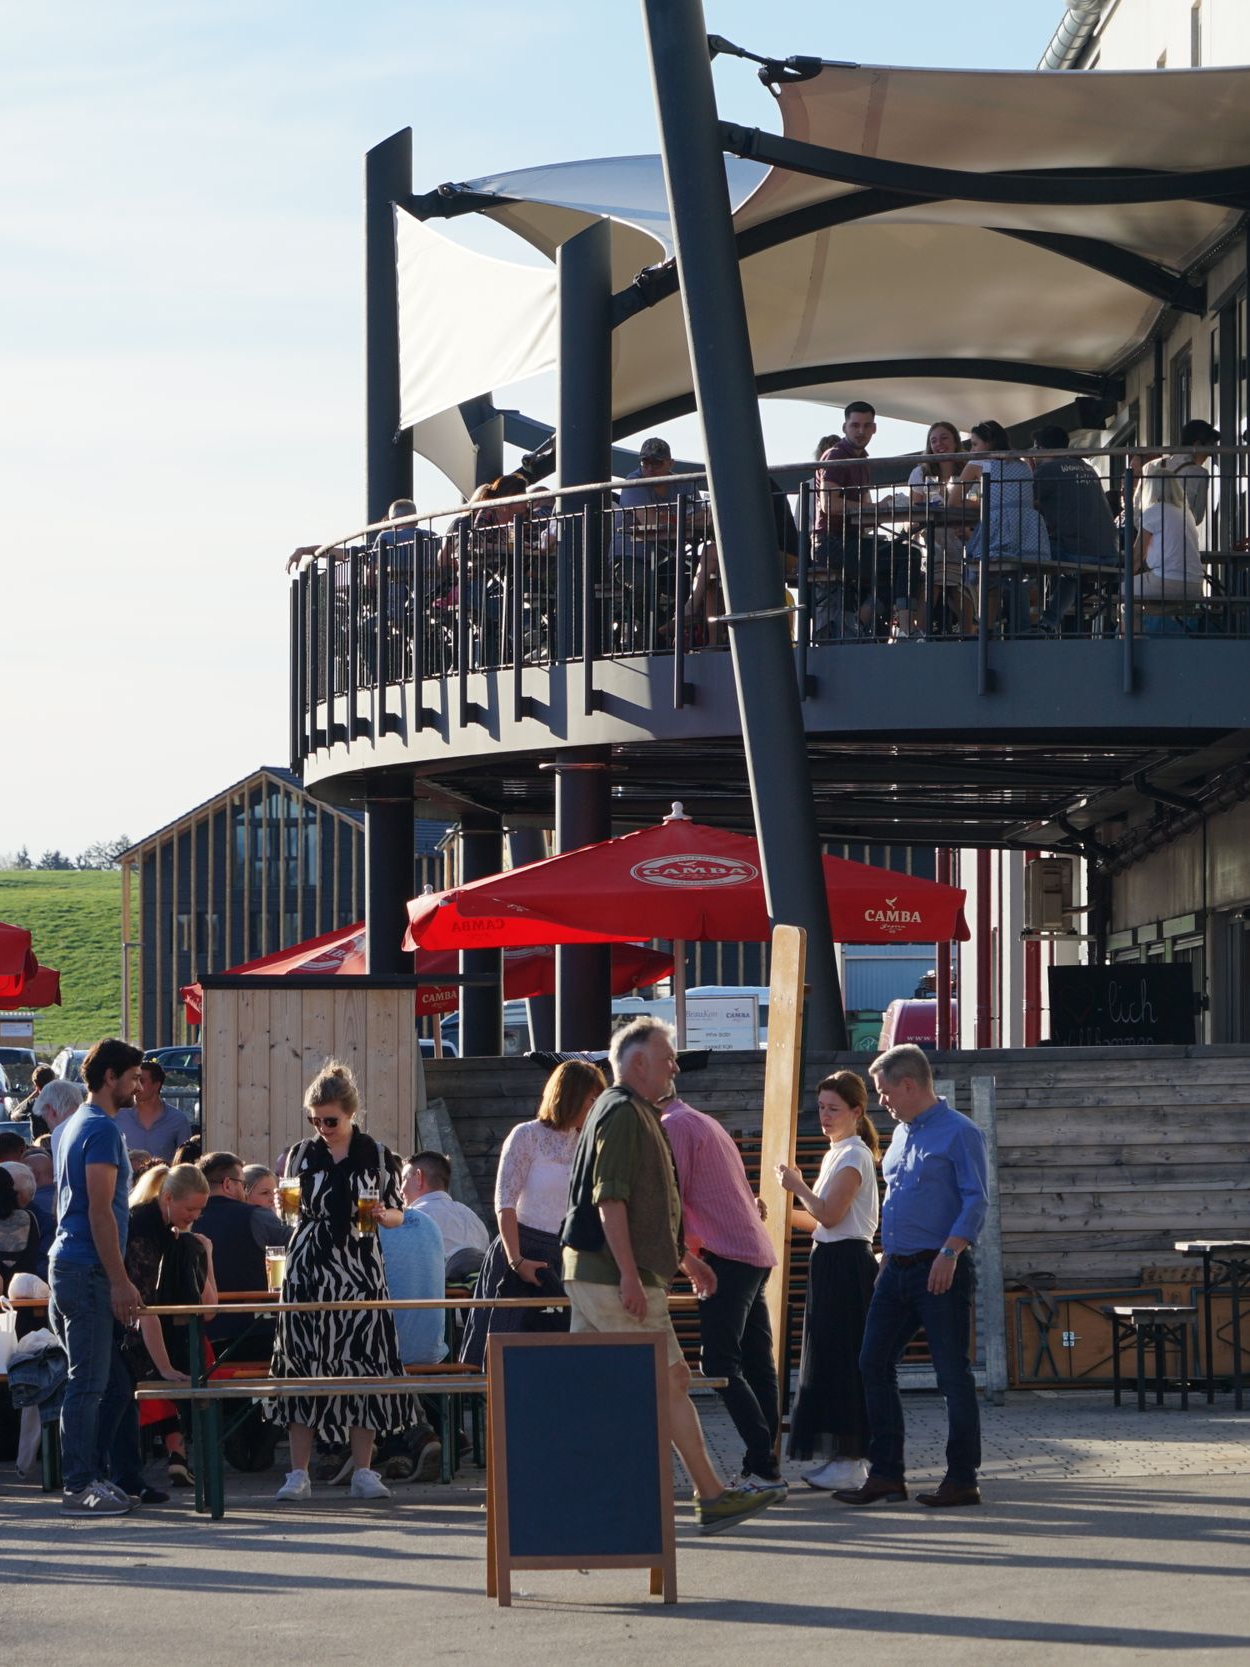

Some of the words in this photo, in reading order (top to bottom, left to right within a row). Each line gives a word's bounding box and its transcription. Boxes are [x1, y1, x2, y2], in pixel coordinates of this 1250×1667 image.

[642, 867, 749, 876] CAMBA
[864, 909, 922, 923] CAMBA
[421, 990, 458, 1003] CAMBA
